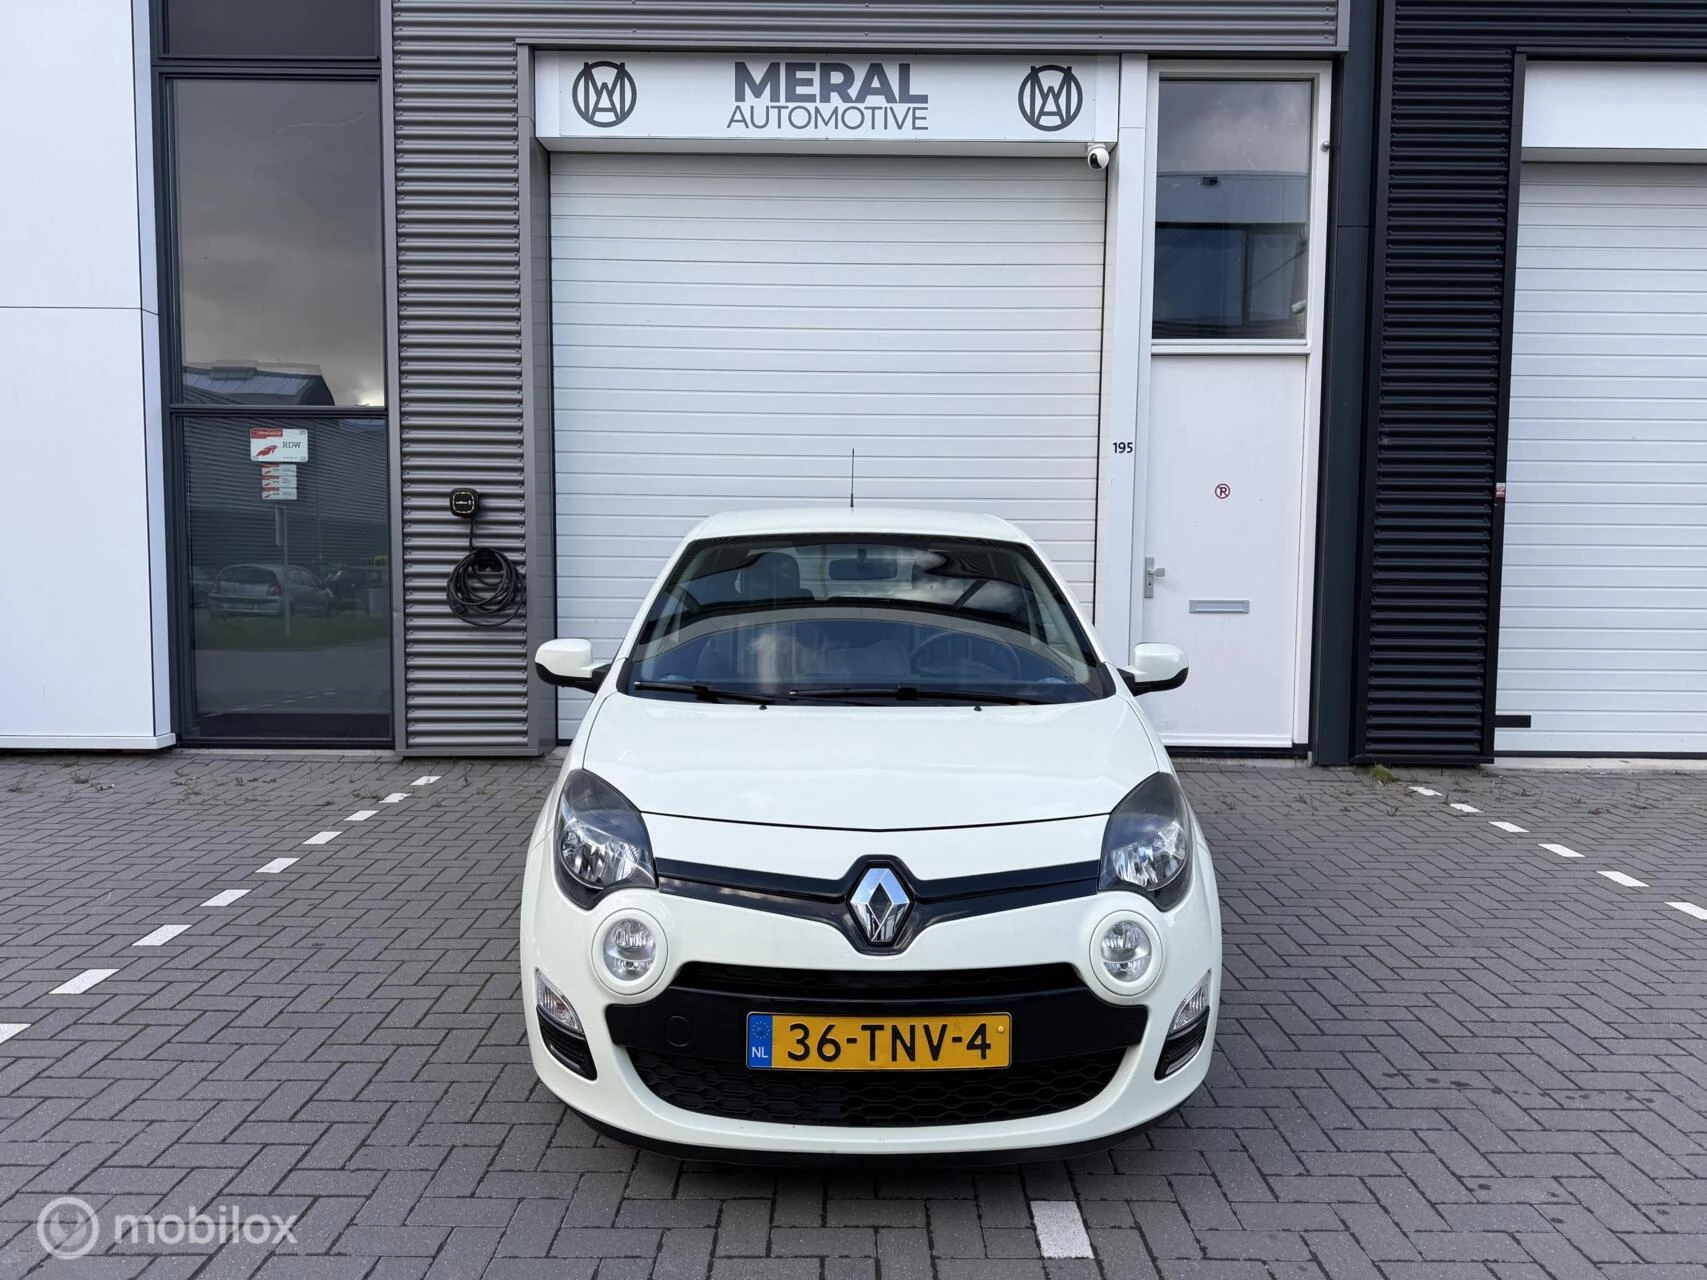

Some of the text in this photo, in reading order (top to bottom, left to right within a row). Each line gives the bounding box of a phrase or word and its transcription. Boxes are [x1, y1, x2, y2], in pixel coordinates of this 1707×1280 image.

[734, 61, 929, 104] MERAL
[726, 105, 929, 131] AUTOMOTIVE
[282, 441, 302, 449] RDW
[1112, 441, 1134, 454] 195
[751, 1022, 992, 1063] NL 36-TNV-4
